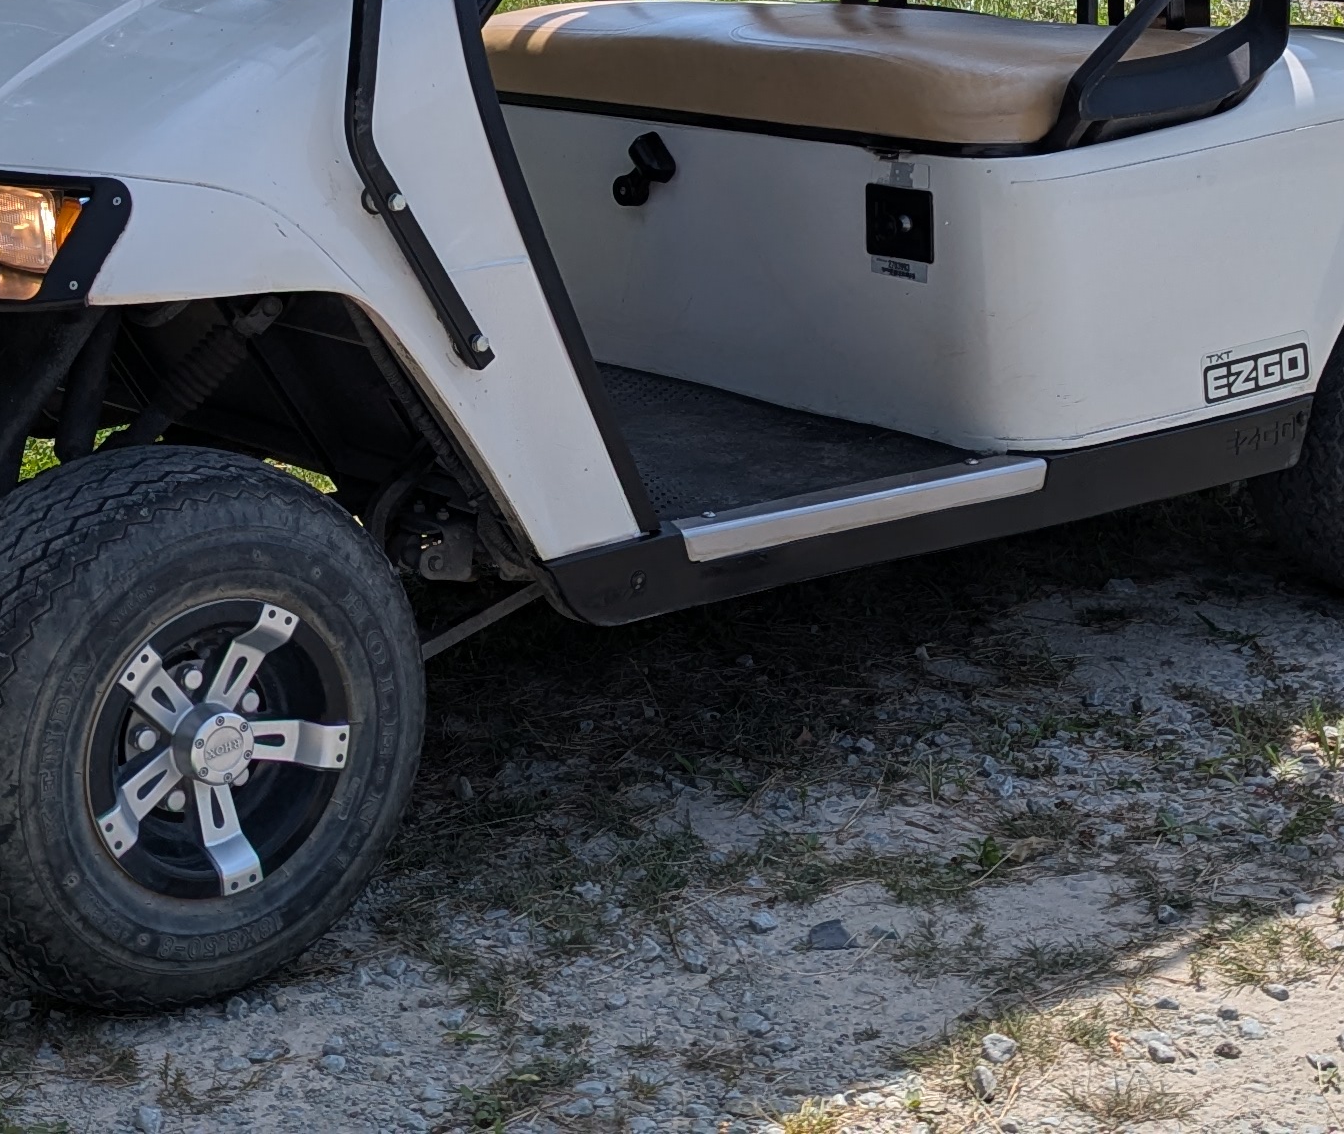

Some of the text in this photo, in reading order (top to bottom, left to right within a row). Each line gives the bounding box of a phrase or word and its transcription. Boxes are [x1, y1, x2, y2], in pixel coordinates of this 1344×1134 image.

[1206, 350, 1233, 364] TXT
[39, 662, 92, 844] KENDA
[206, 739, 241, 760] RHOX
